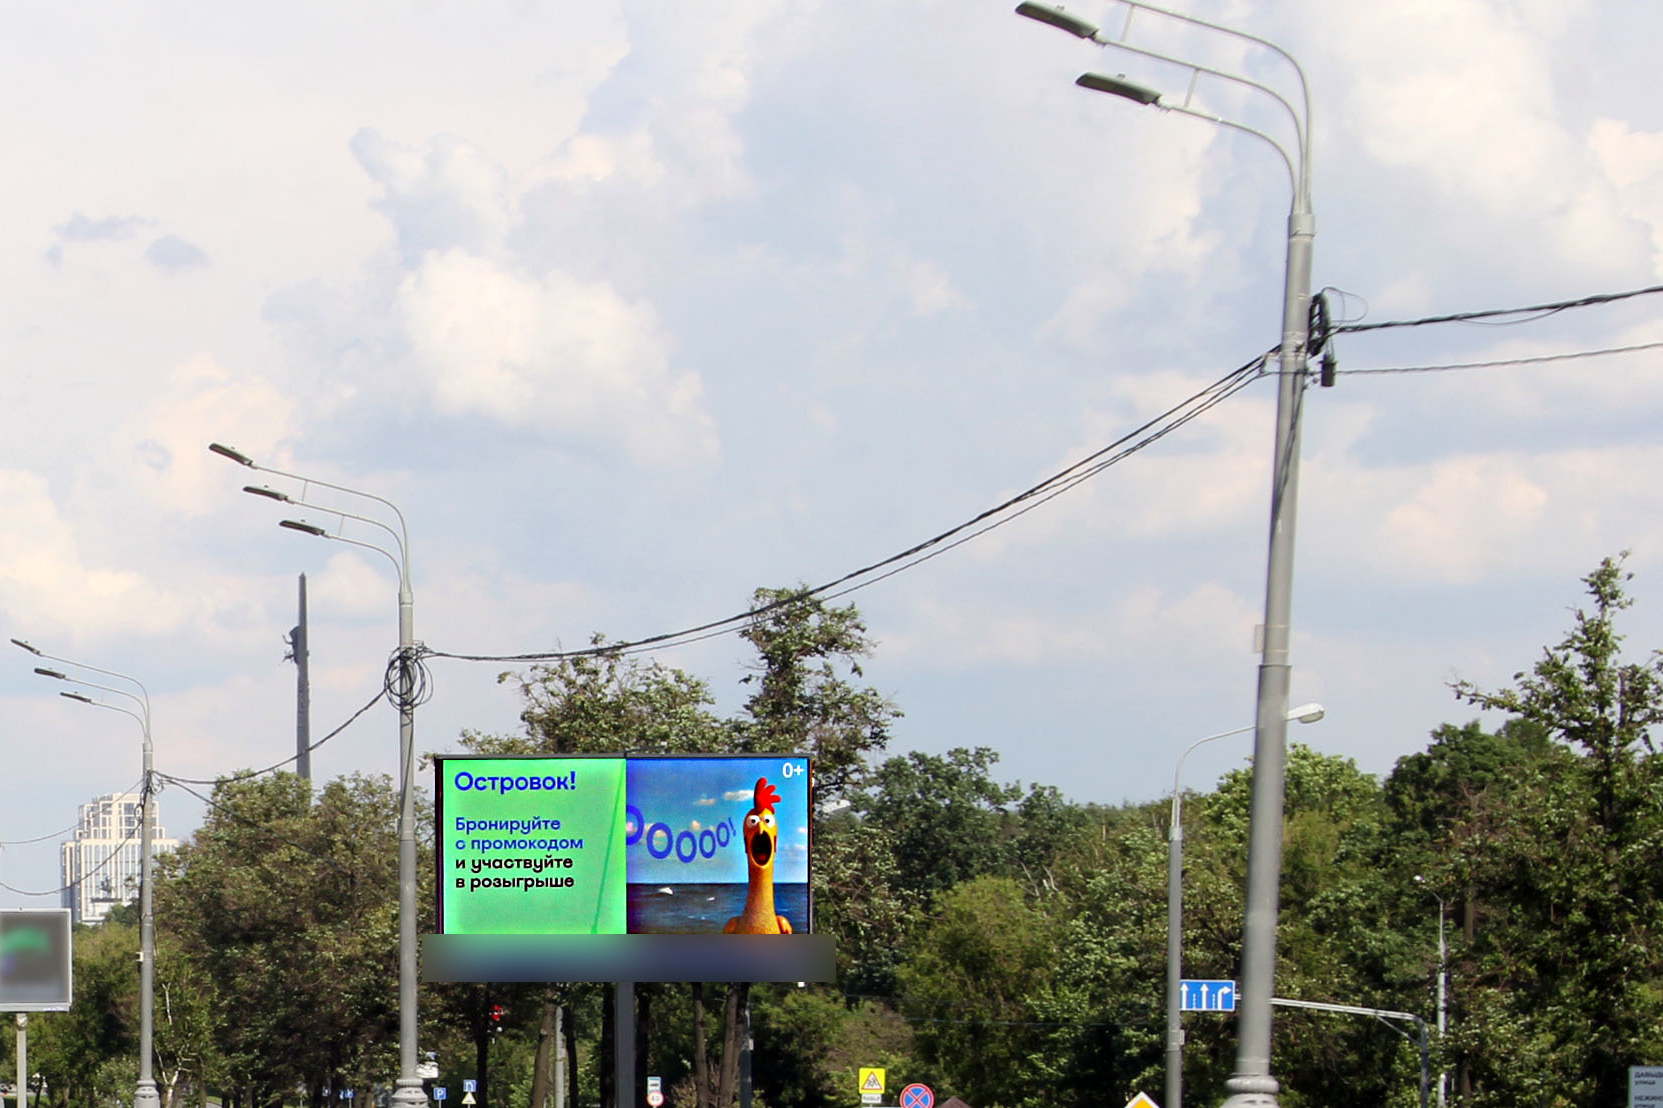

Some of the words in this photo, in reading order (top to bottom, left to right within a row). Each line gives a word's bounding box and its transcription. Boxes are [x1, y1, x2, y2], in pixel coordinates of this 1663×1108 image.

[782, 762, 805, 779] 0+
[454, 771, 576, 795] Островок!
[455, 816, 561, 835] Бронируйте
[455, 840, 466, 850] с
[471, 838, 584, 854] промокодом
[455, 859, 466, 869] и
[471, 855, 573, 874] участвуйте
[455, 878, 465, 888] в
[470, 876, 575, 892] розыгрыше
